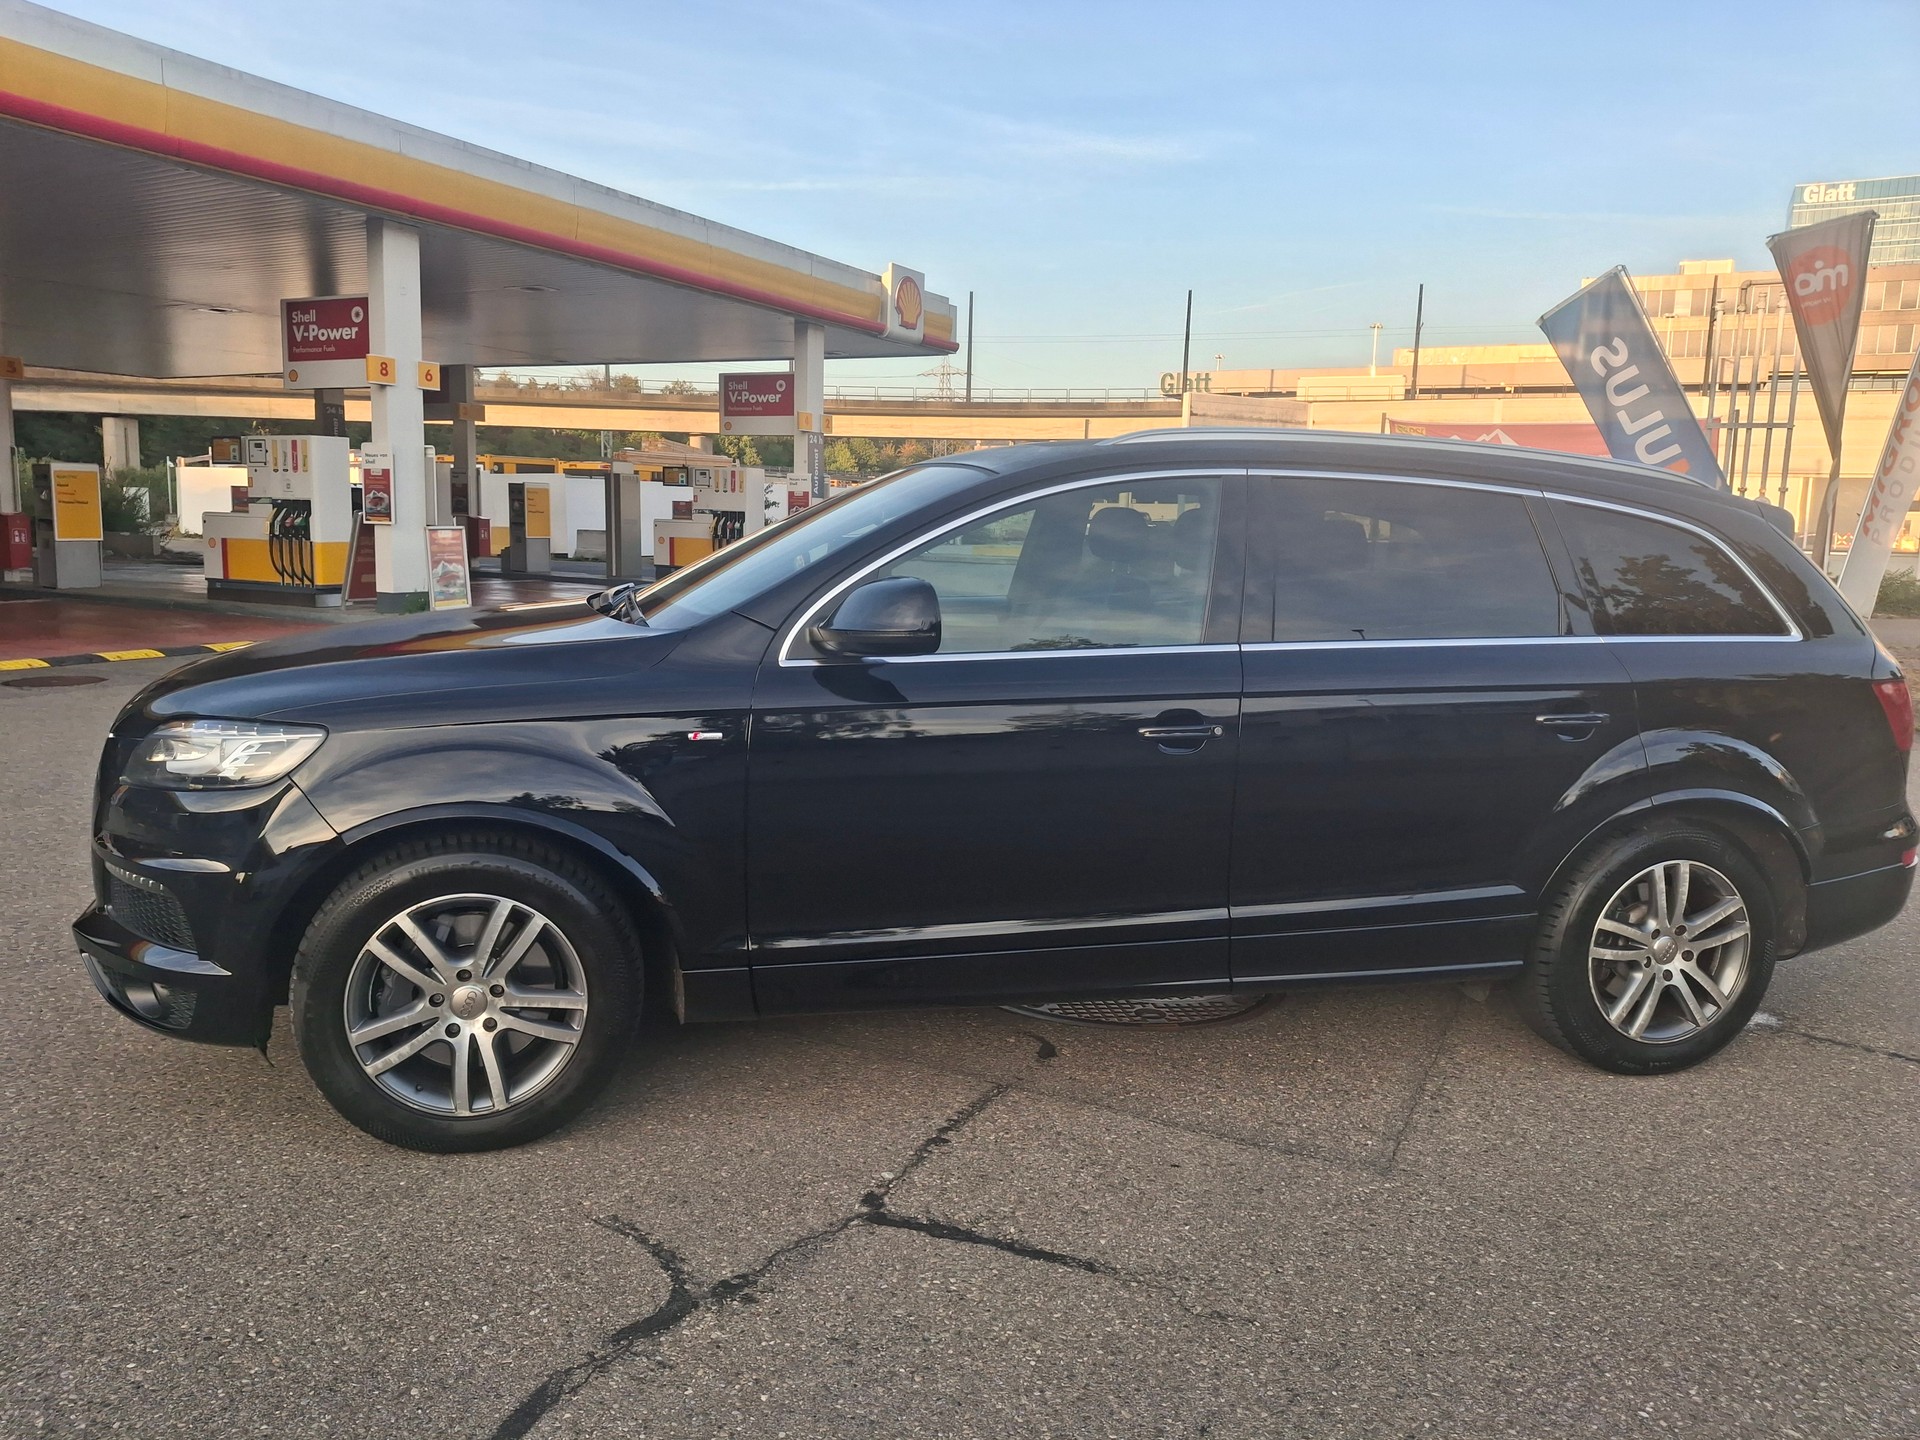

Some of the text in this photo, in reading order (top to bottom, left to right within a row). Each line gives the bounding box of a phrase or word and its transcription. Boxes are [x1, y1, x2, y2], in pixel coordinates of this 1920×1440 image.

[1803, 183, 1856, 203] Glatt
[292, 309, 316, 323] Shell
[293, 324, 359, 342] V-Power
[293, 344, 336, 353] Performance Fuels
[380, 361, 389, 377] 8
[425, 369, 433, 382] 6
[728, 381, 748, 391] Shell
[728, 391, 782, 403] V-Power
[825, 418, 830, 428] 2
[809, 434, 818, 444] 24
[1862, 363, 1920, 537] MIGRO
